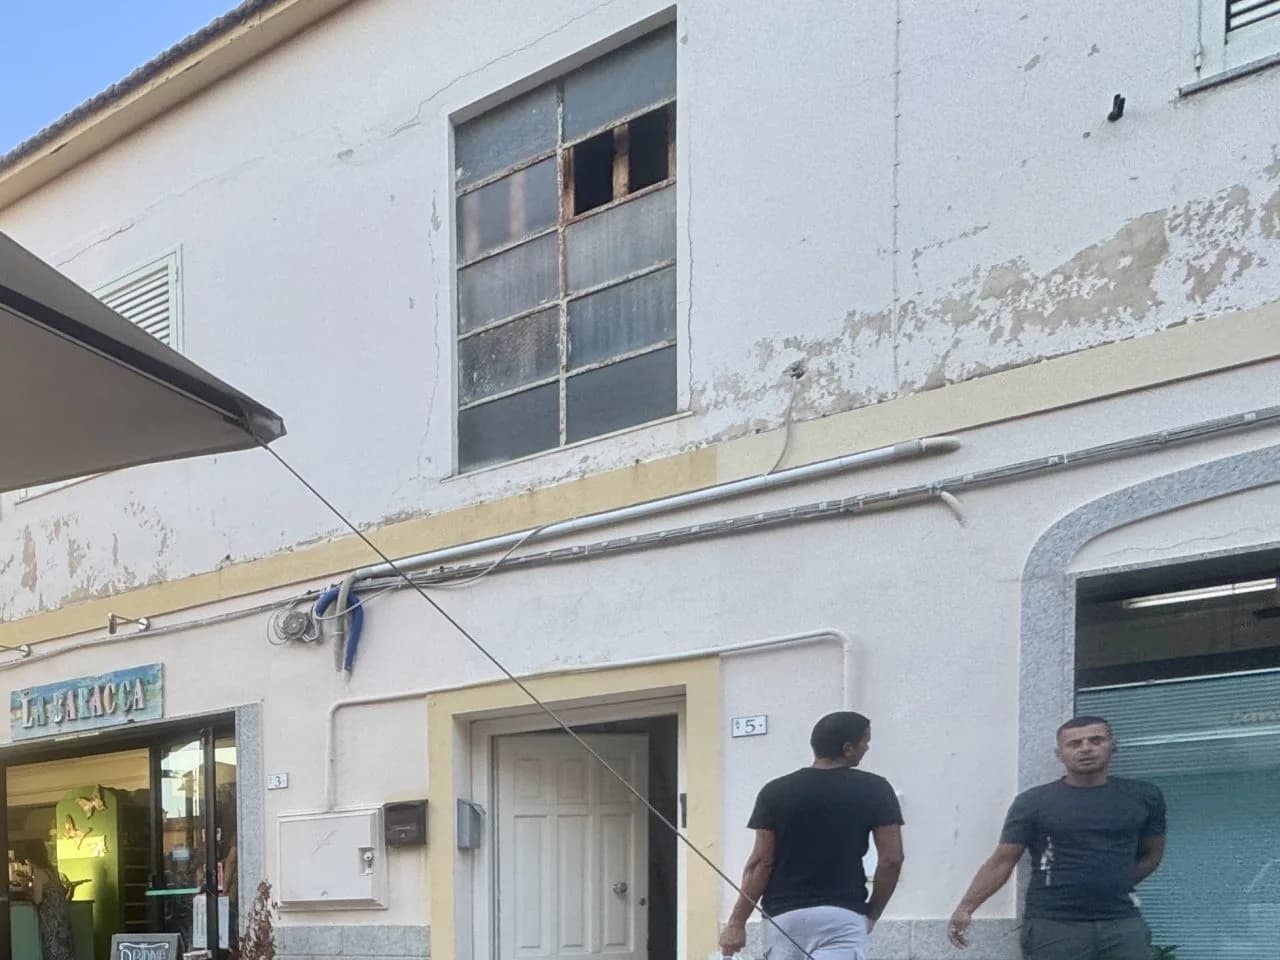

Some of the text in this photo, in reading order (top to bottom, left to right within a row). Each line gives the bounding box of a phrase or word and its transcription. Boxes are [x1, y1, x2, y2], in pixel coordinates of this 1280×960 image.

[53, 677, 145, 724] BARACCA
[744, 719, 756, 734] 5
[274, 775, 282, 787] 3
